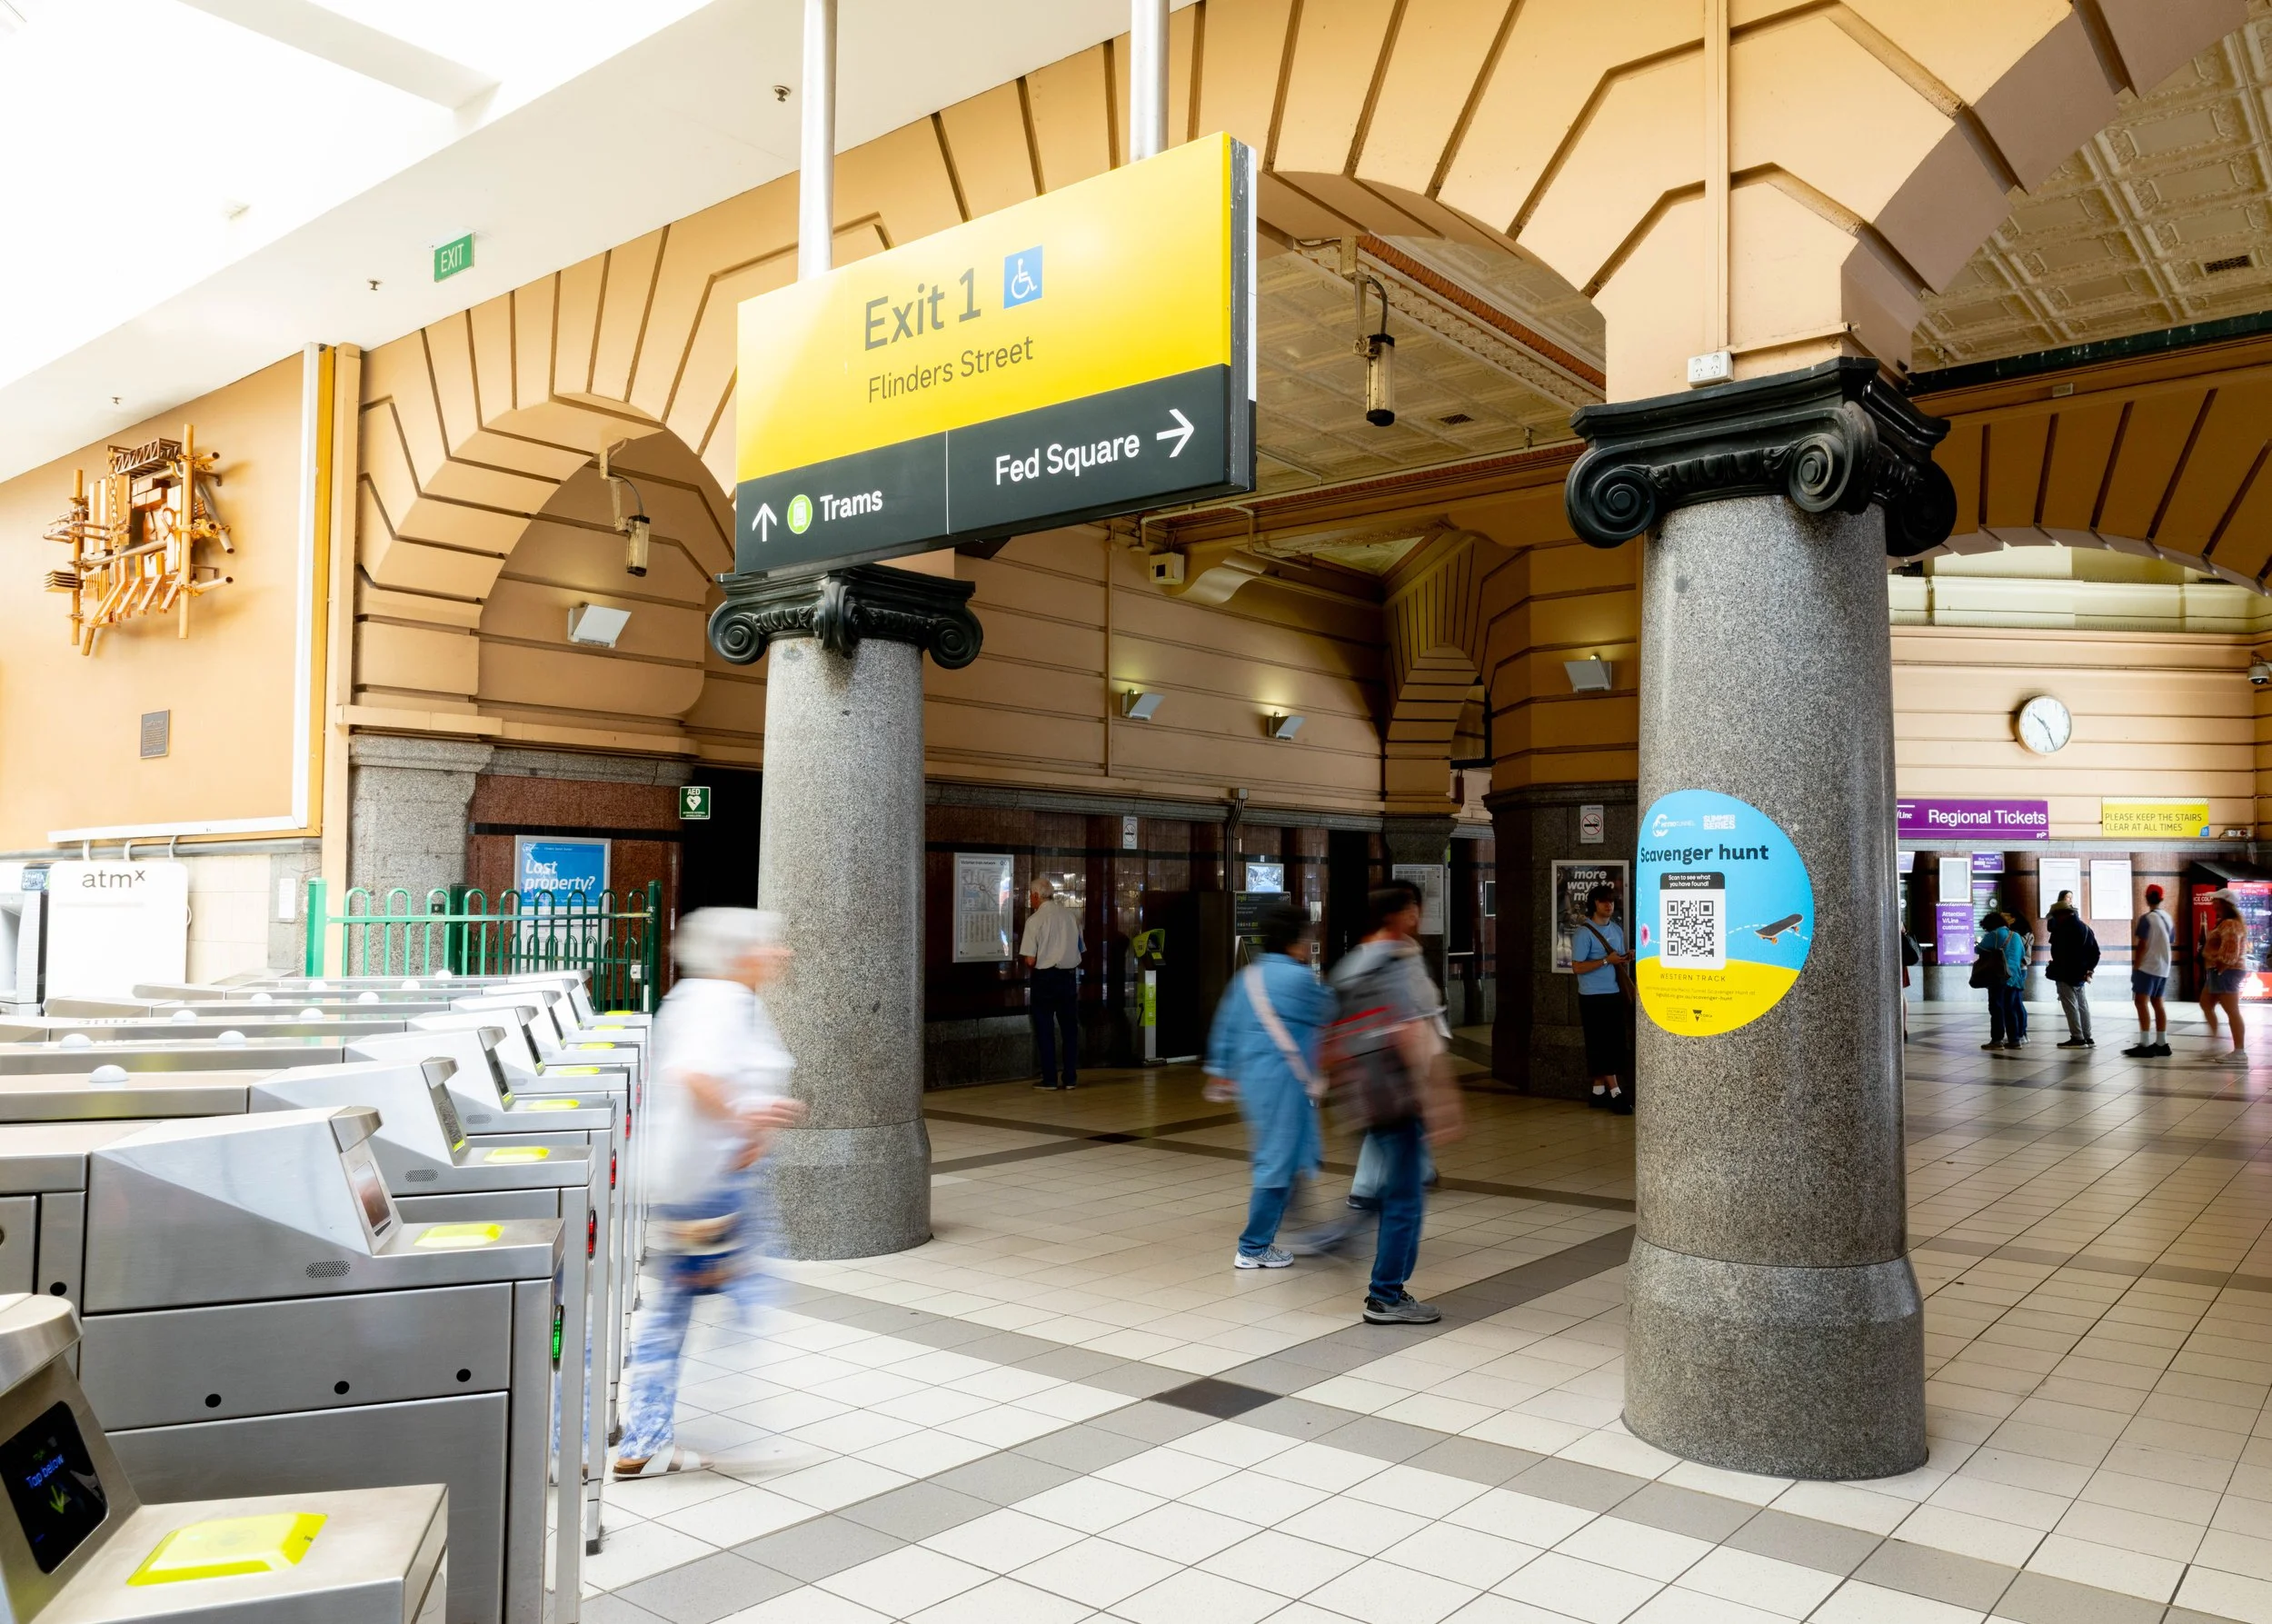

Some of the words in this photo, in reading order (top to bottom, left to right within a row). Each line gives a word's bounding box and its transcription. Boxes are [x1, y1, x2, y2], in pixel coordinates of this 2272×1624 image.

[441, 243, 464, 273] EXIT
[864, 283, 945, 351] Exit
[958, 267, 982, 323] 1
[869, 364, 953, 404] Flinders
[961, 335, 1033, 377] Street
[996, 448, 1040, 485] Fed
[1046, 434, 1141, 477] Square
[820, 490, 883, 522] Trams
[1897, 809, 1912, 819] /Line
[1928, 810, 1991, 827] Regional
[1994, 810, 2047, 824] Tickets
[2176, 813, 2202, 822] STAIRS
[1703, 821, 1736, 830] SERIES
[1640, 846, 1713, 865] Scavenger
[1719, 843, 1769, 860] hunt
[525, 860, 558, 874] Lost
[1573, 870, 1607, 880] more
[523, 876, 596, 893] property?
[41, 1455, 65, 1477] below
